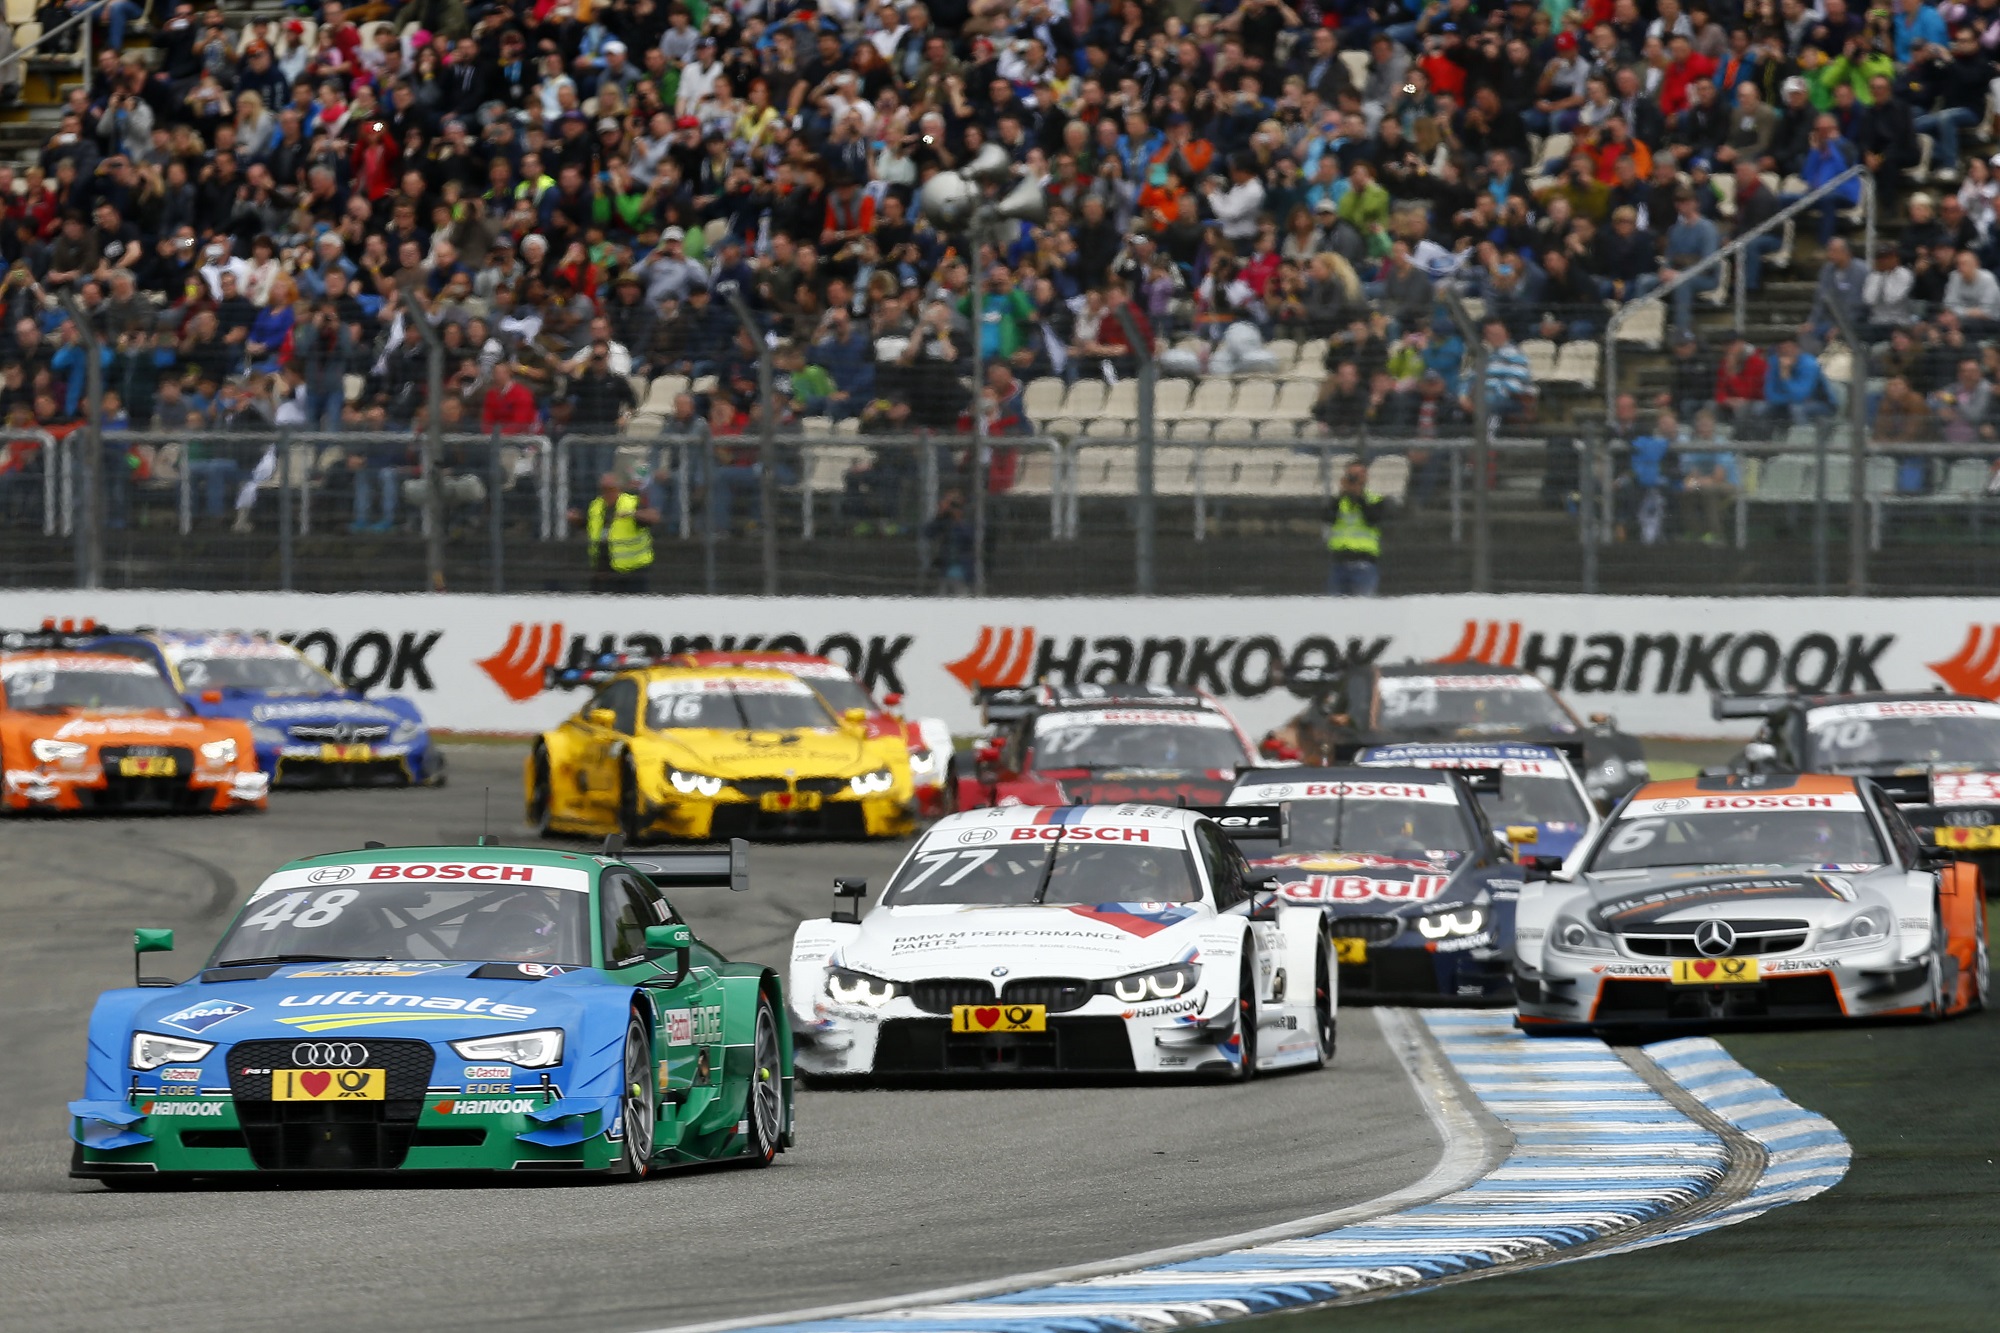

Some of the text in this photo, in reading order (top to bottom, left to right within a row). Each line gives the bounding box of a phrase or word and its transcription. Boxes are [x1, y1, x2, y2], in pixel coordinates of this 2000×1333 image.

[654, 698, 703, 723] 16
[1877, 702, 1977, 715] BOSCH
[1044, 727, 1097, 754] 17
[1819, 719, 1871, 750] 10
[1373, 747, 1499, 759] SAMSUNG
[1306, 784, 1427, 798] BOSCH
[1704, 796, 1832, 809] BOSCH
[1010, 827, 1149, 842] BOSCH
[1608, 818, 1667, 854] 6
[368, 864, 533, 882] BOSCH
[901, 849, 998, 893] 77
[241, 888, 360, 931] 48
[894, 932, 944, 943] BMW
[971, 930, 1128, 941] PERFORMANCE
[892, 939, 957, 952] PARTS
[279, 991, 537, 1019] ultimate
[170, 1006, 240, 1022] ARAL
[476, 1067, 510, 1078] Castrol
[158, 1085, 198, 1096] EDGE
[465, 1083, 512, 1094] EDGE
